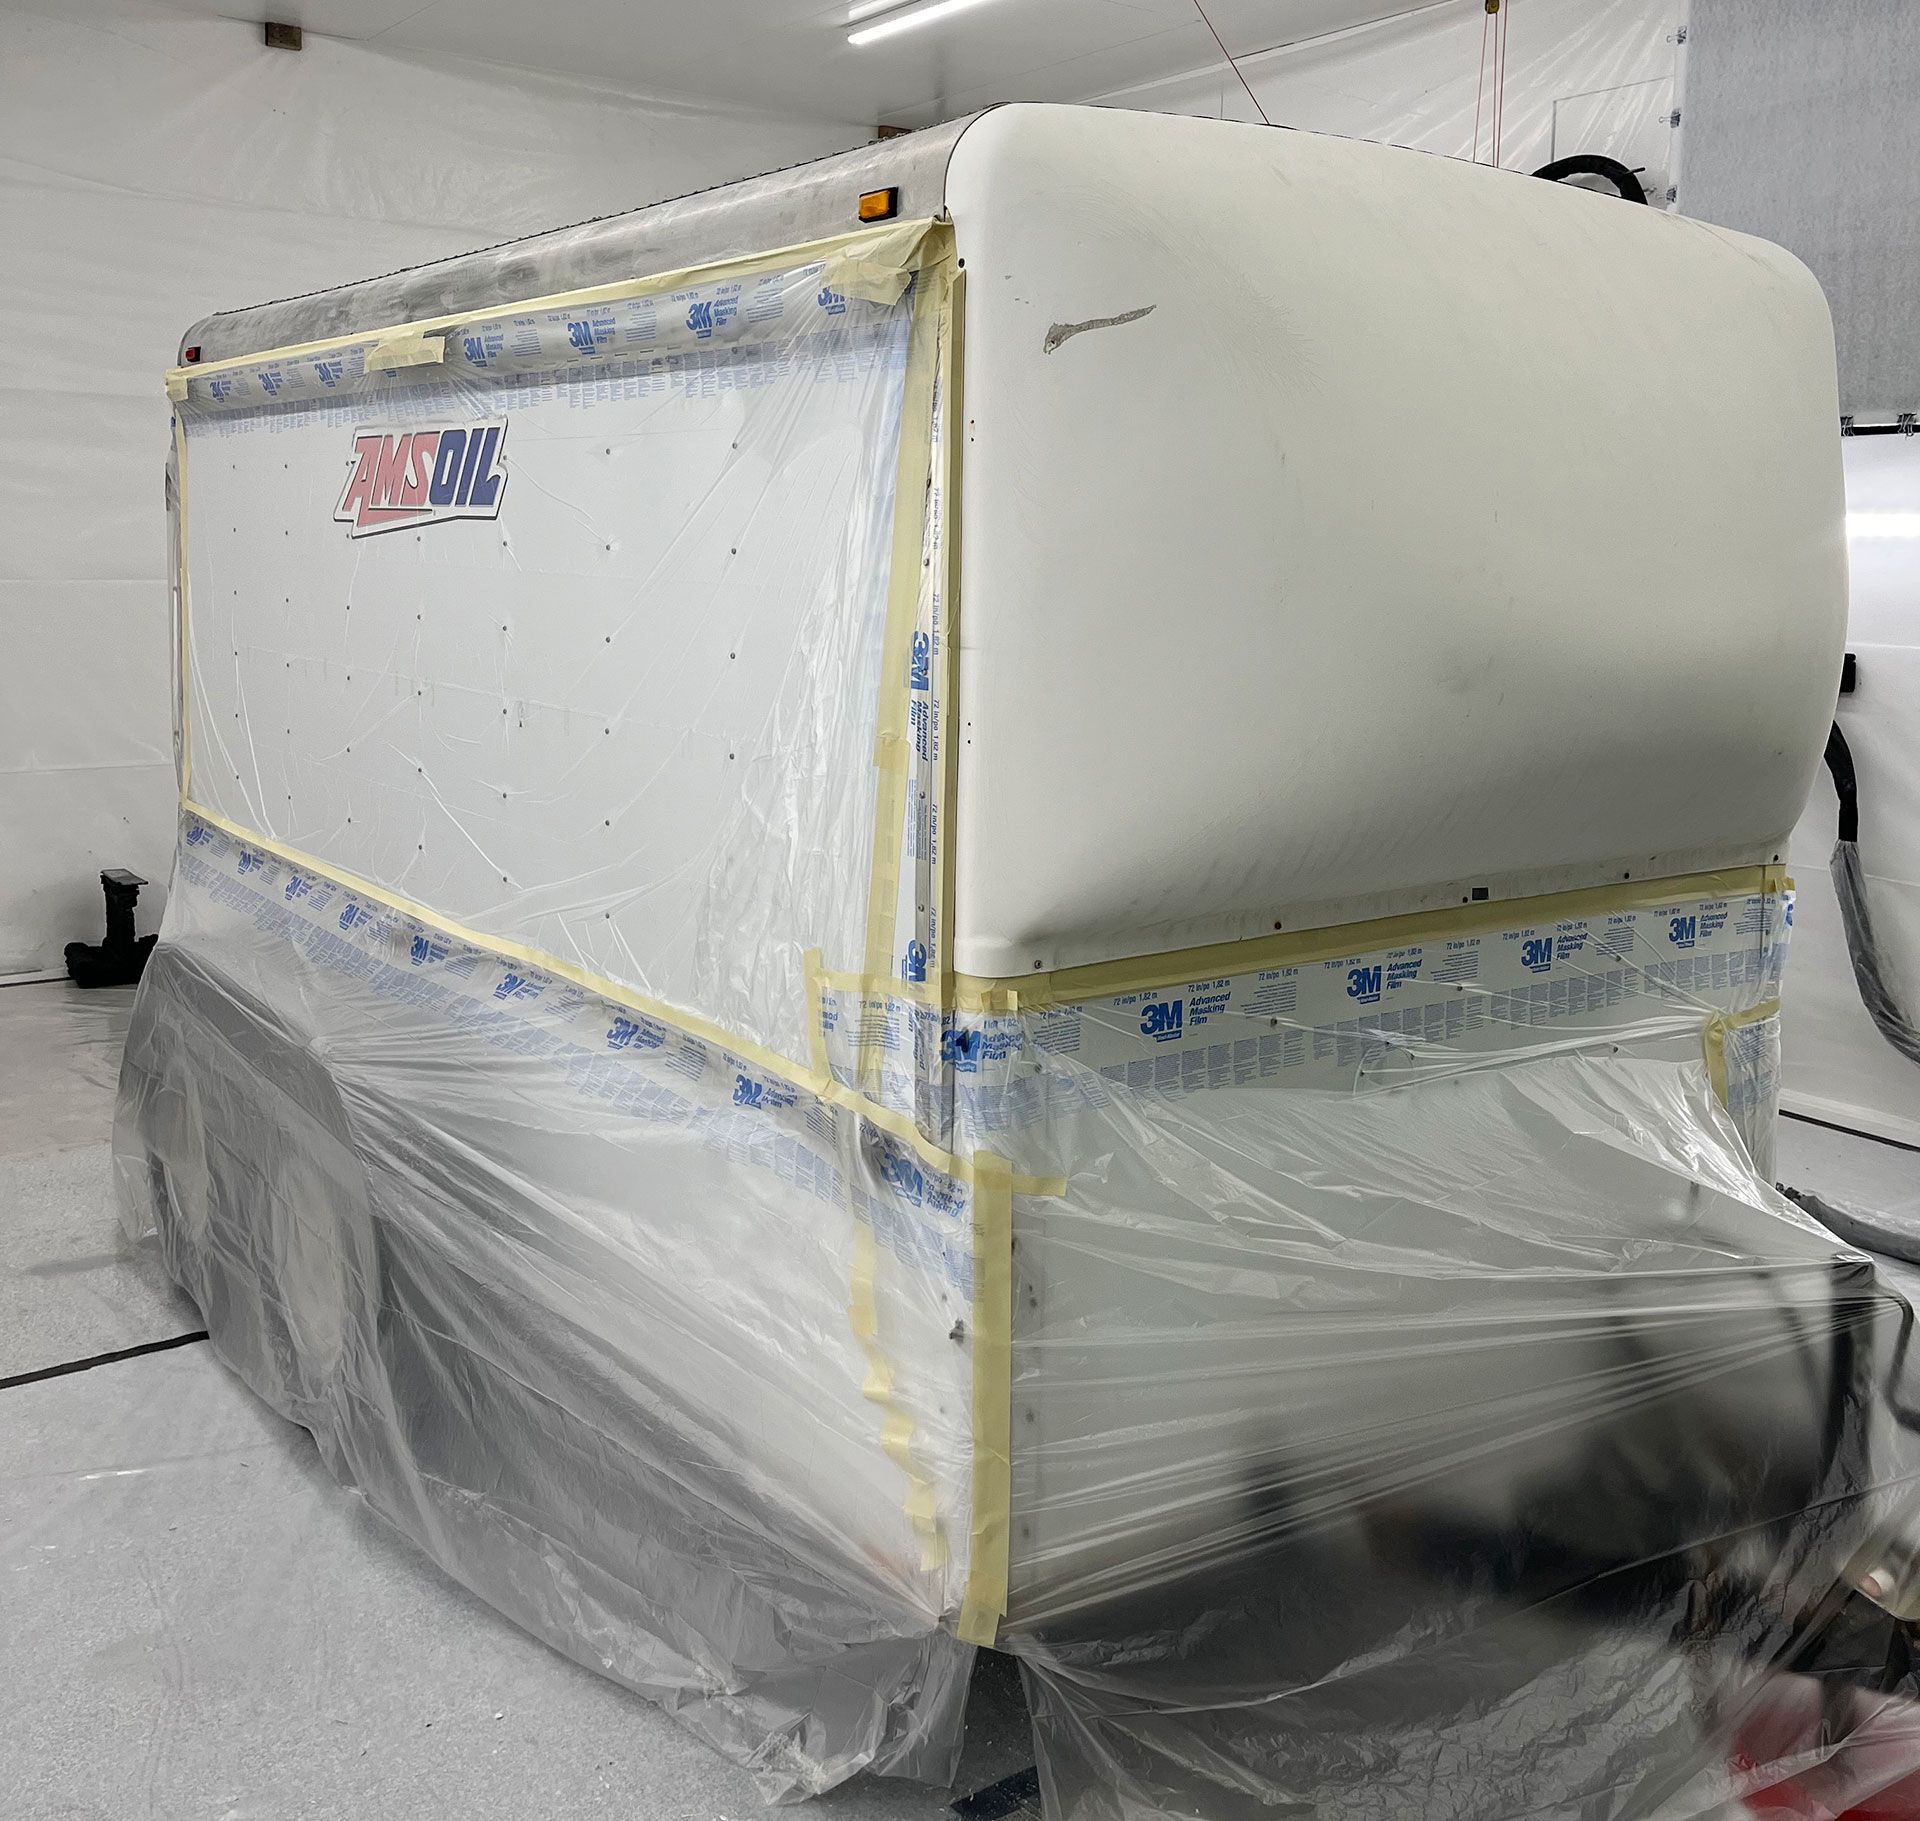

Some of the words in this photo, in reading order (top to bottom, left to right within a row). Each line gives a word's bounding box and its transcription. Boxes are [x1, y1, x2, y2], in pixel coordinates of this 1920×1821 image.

[713, 295, 739, 307] Advanced
[686, 301, 712, 330] 3M
[714, 306, 737, 317] Masking
[567, 321, 593, 348] 3M
[463, 337, 485, 361] 3M
[342, 427, 501, 527] AMSOIL
[911, 631, 930, 691] 3M
[934, 699, 940, 709] 72
[921, 700, 929, 761] Advanced
[1700, 911, 1728, 922] Advanced
[1668, 915, 1696, 943] 3M
[1700, 920, 1724, 929] Masking
[1556, 932, 1588, 944] Advanced
[1700, 929, 1712, 938] Film
[410, 935, 430, 961] 3M
[1446, 942, 1452, 950] 72
[1521, 937, 1553, 967] 3M
[1556, 942, 1584, 952] Masking
[1556, 951, 1570, 960] Film
[1386, 959, 1423, 972] Advanced
[1259, 973, 1265, 981] 72
[1266, 971, 1280, 980] in/po
[1346, 965, 1382, 997] 3M
[1386, 970, 1417, 981] Masking
[495, 973, 526, 994] 3M
[1196, 983, 1210, 991] in/po
[1386, 981, 1402, 990] Film
[1113, 998, 1121, 1006] 72
[1122, 995, 1136, 1004] in/po
[1189, 991, 1231, 1007] Advanced
[1189, 1003, 1225, 1017] Masking
[1140, 1000, 1183, 1034] 3M
[1189, 1016, 1208, 1026] Film
[607, 1016, 639, 1046] 3M
[733, 1074, 763, 1104] 3M
